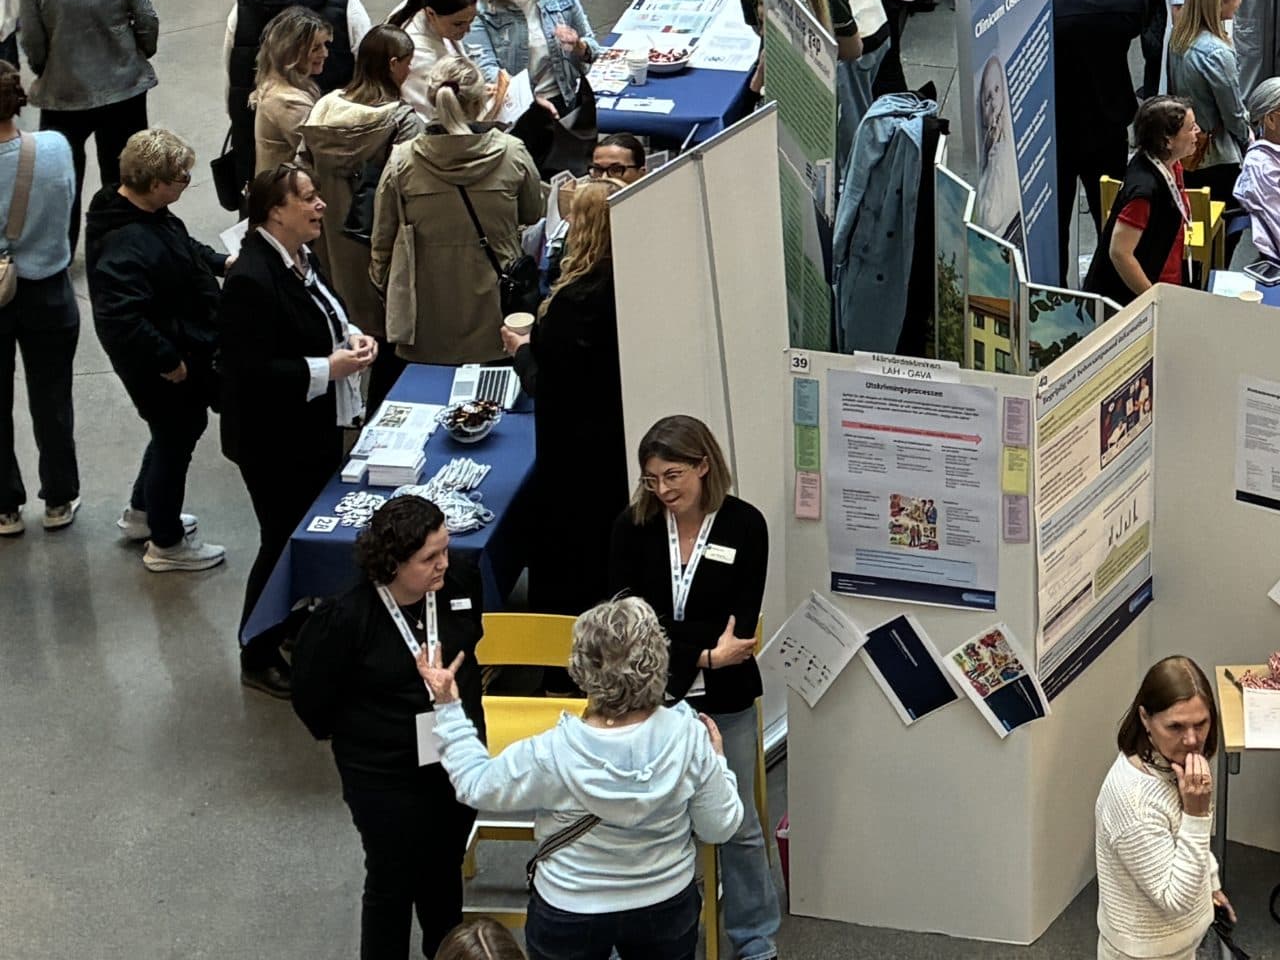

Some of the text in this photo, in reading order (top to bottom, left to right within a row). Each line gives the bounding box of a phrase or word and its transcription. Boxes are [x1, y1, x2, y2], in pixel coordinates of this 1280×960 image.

[975, 4, 1005, 38] Clinicum
[792, 357, 808, 368] 39
[882, 367, 900, 376] LAH
[313, 518, 333, 530] 28
